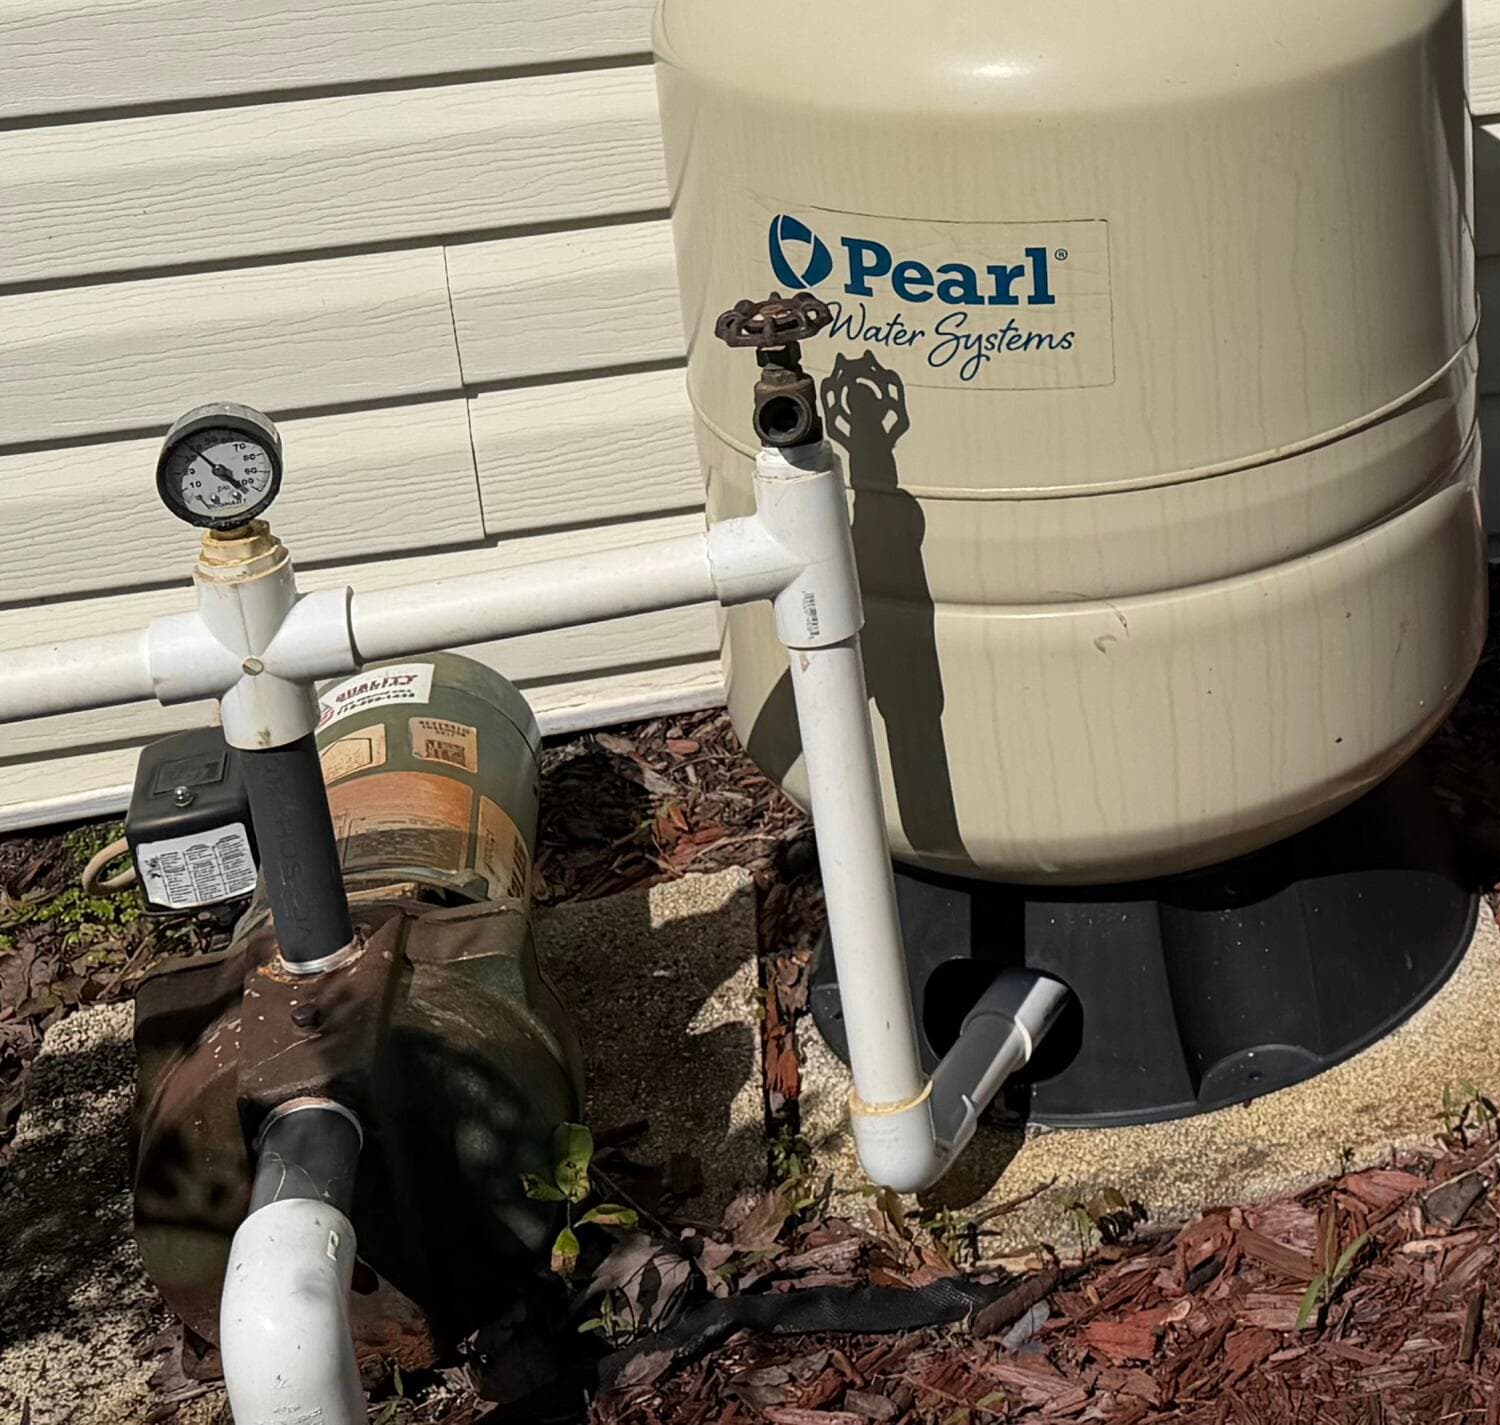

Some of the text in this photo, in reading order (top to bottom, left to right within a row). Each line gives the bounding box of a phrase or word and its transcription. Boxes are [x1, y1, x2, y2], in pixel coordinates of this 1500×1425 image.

[841, 237, 1055, 306] Pearl
[827, 301, 1075, 381] Water Systems
[233, 442, 246, 453] 70
[189, 480, 202, 489] 10
[335, 674, 419, 703] QUALITY
